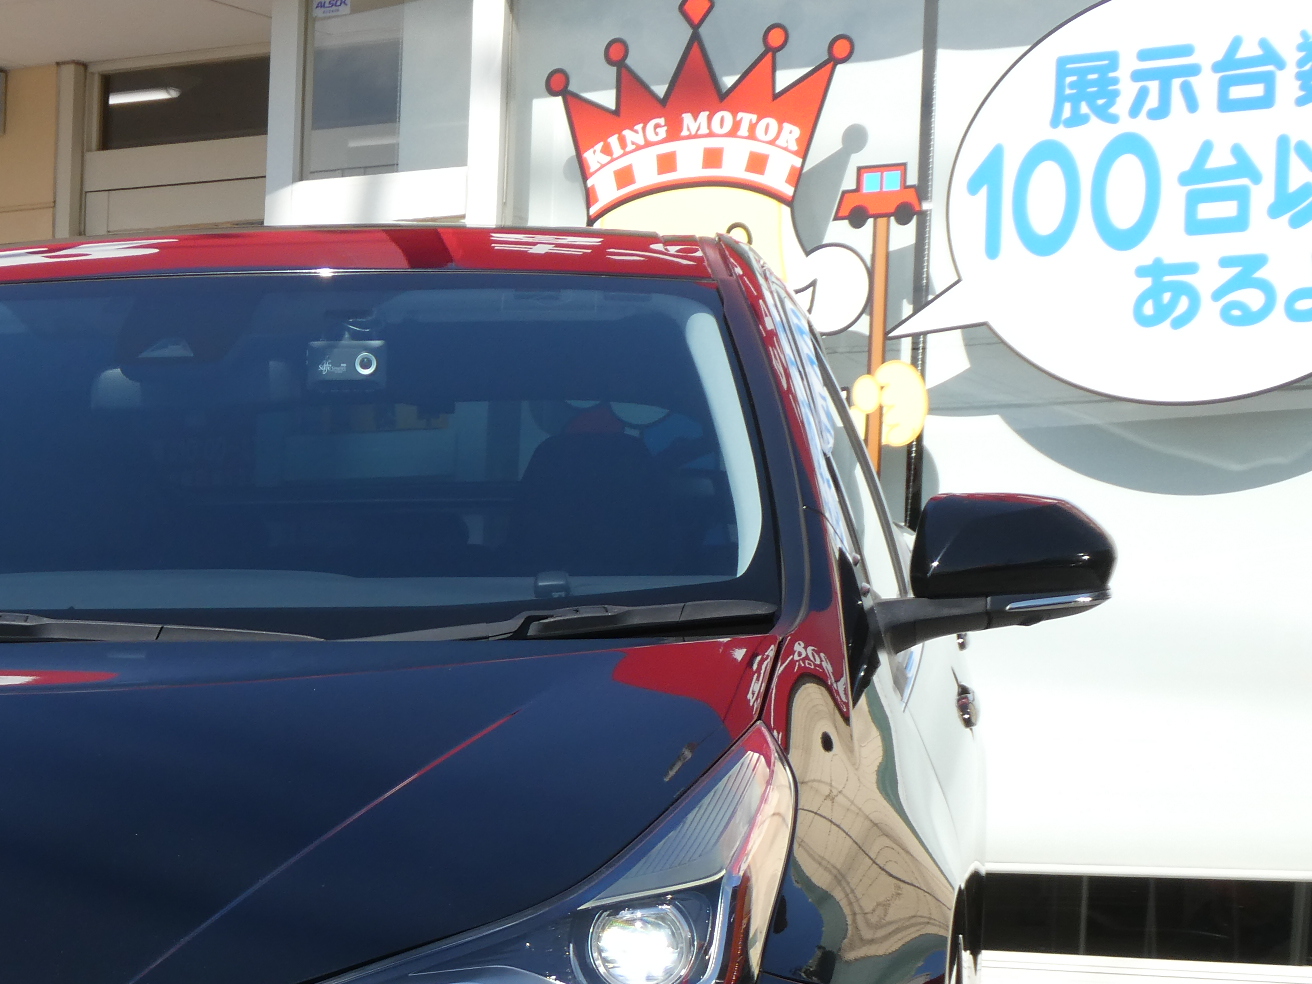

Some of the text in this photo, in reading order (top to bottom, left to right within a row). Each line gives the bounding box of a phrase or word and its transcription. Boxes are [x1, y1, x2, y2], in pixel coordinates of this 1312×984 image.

[1049, 29, 1312, 129] 展示台
[582, 111, 801, 172] KING MOTOR
